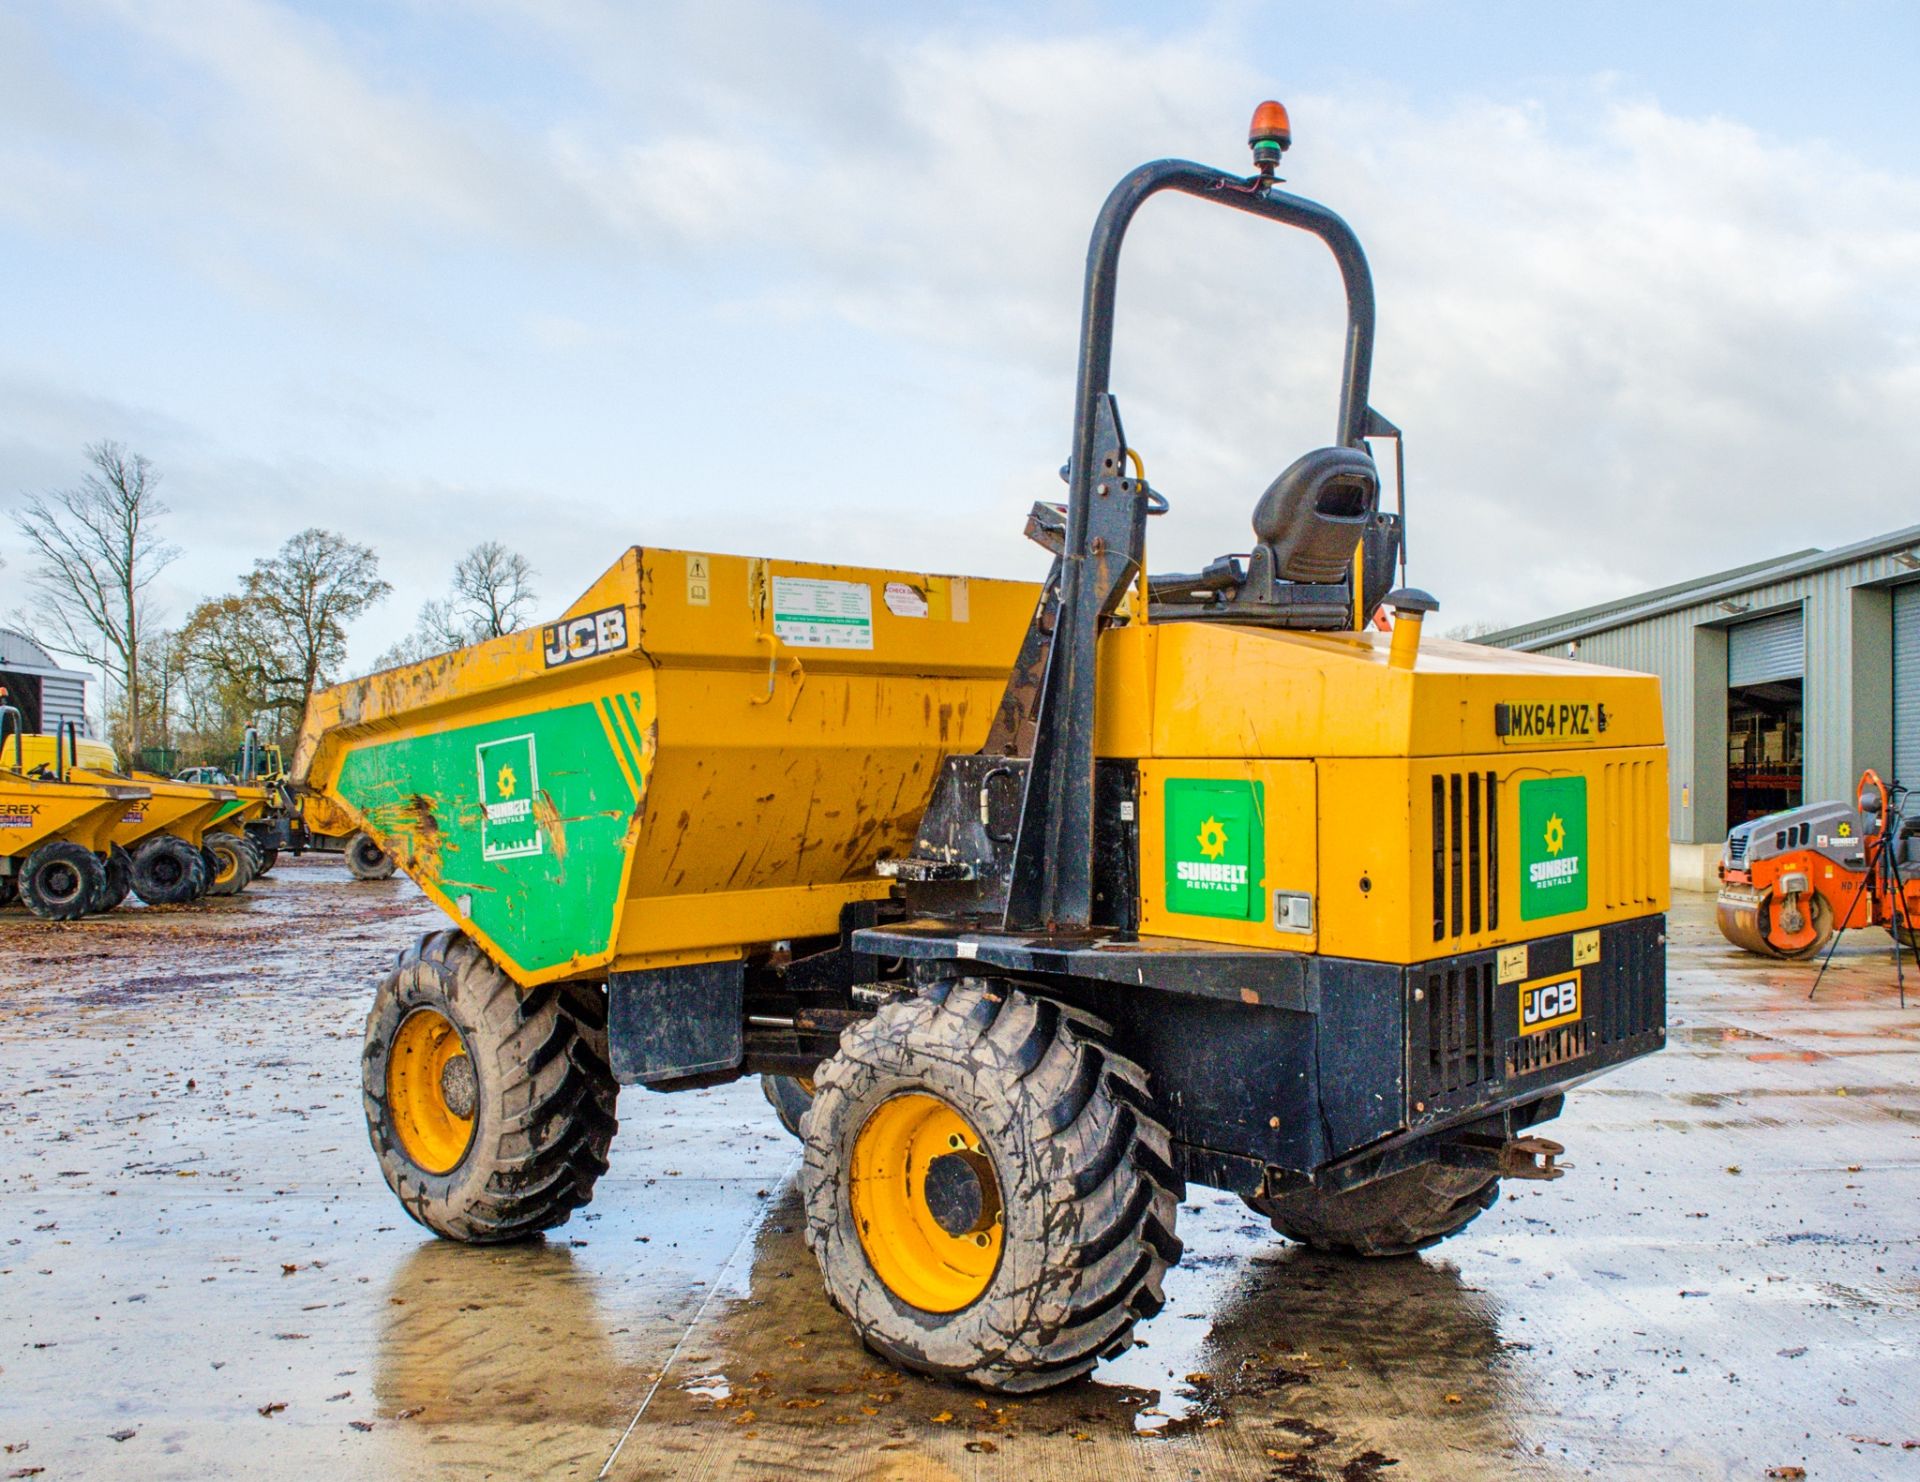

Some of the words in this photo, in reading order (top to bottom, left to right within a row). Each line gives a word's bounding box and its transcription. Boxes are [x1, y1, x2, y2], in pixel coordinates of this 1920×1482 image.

[545, 609, 626, 665] JCB
[1511, 704, 1555, 736] MX64
[1559, 704, 1589, 735] PXZ
[487, 799, 531, 820] SUNBELT
[492, 815, 525, 825] RENTALS
[1176, 861, 1248, 884] SUNBELT
[1530, 856, 1579, 882] SUNBELT
[1186, 881, 1238, 892] RENTALS
[1536, 876, 1572, 889] RENTALS
[1524, 981, 1577, 1024] JCB
